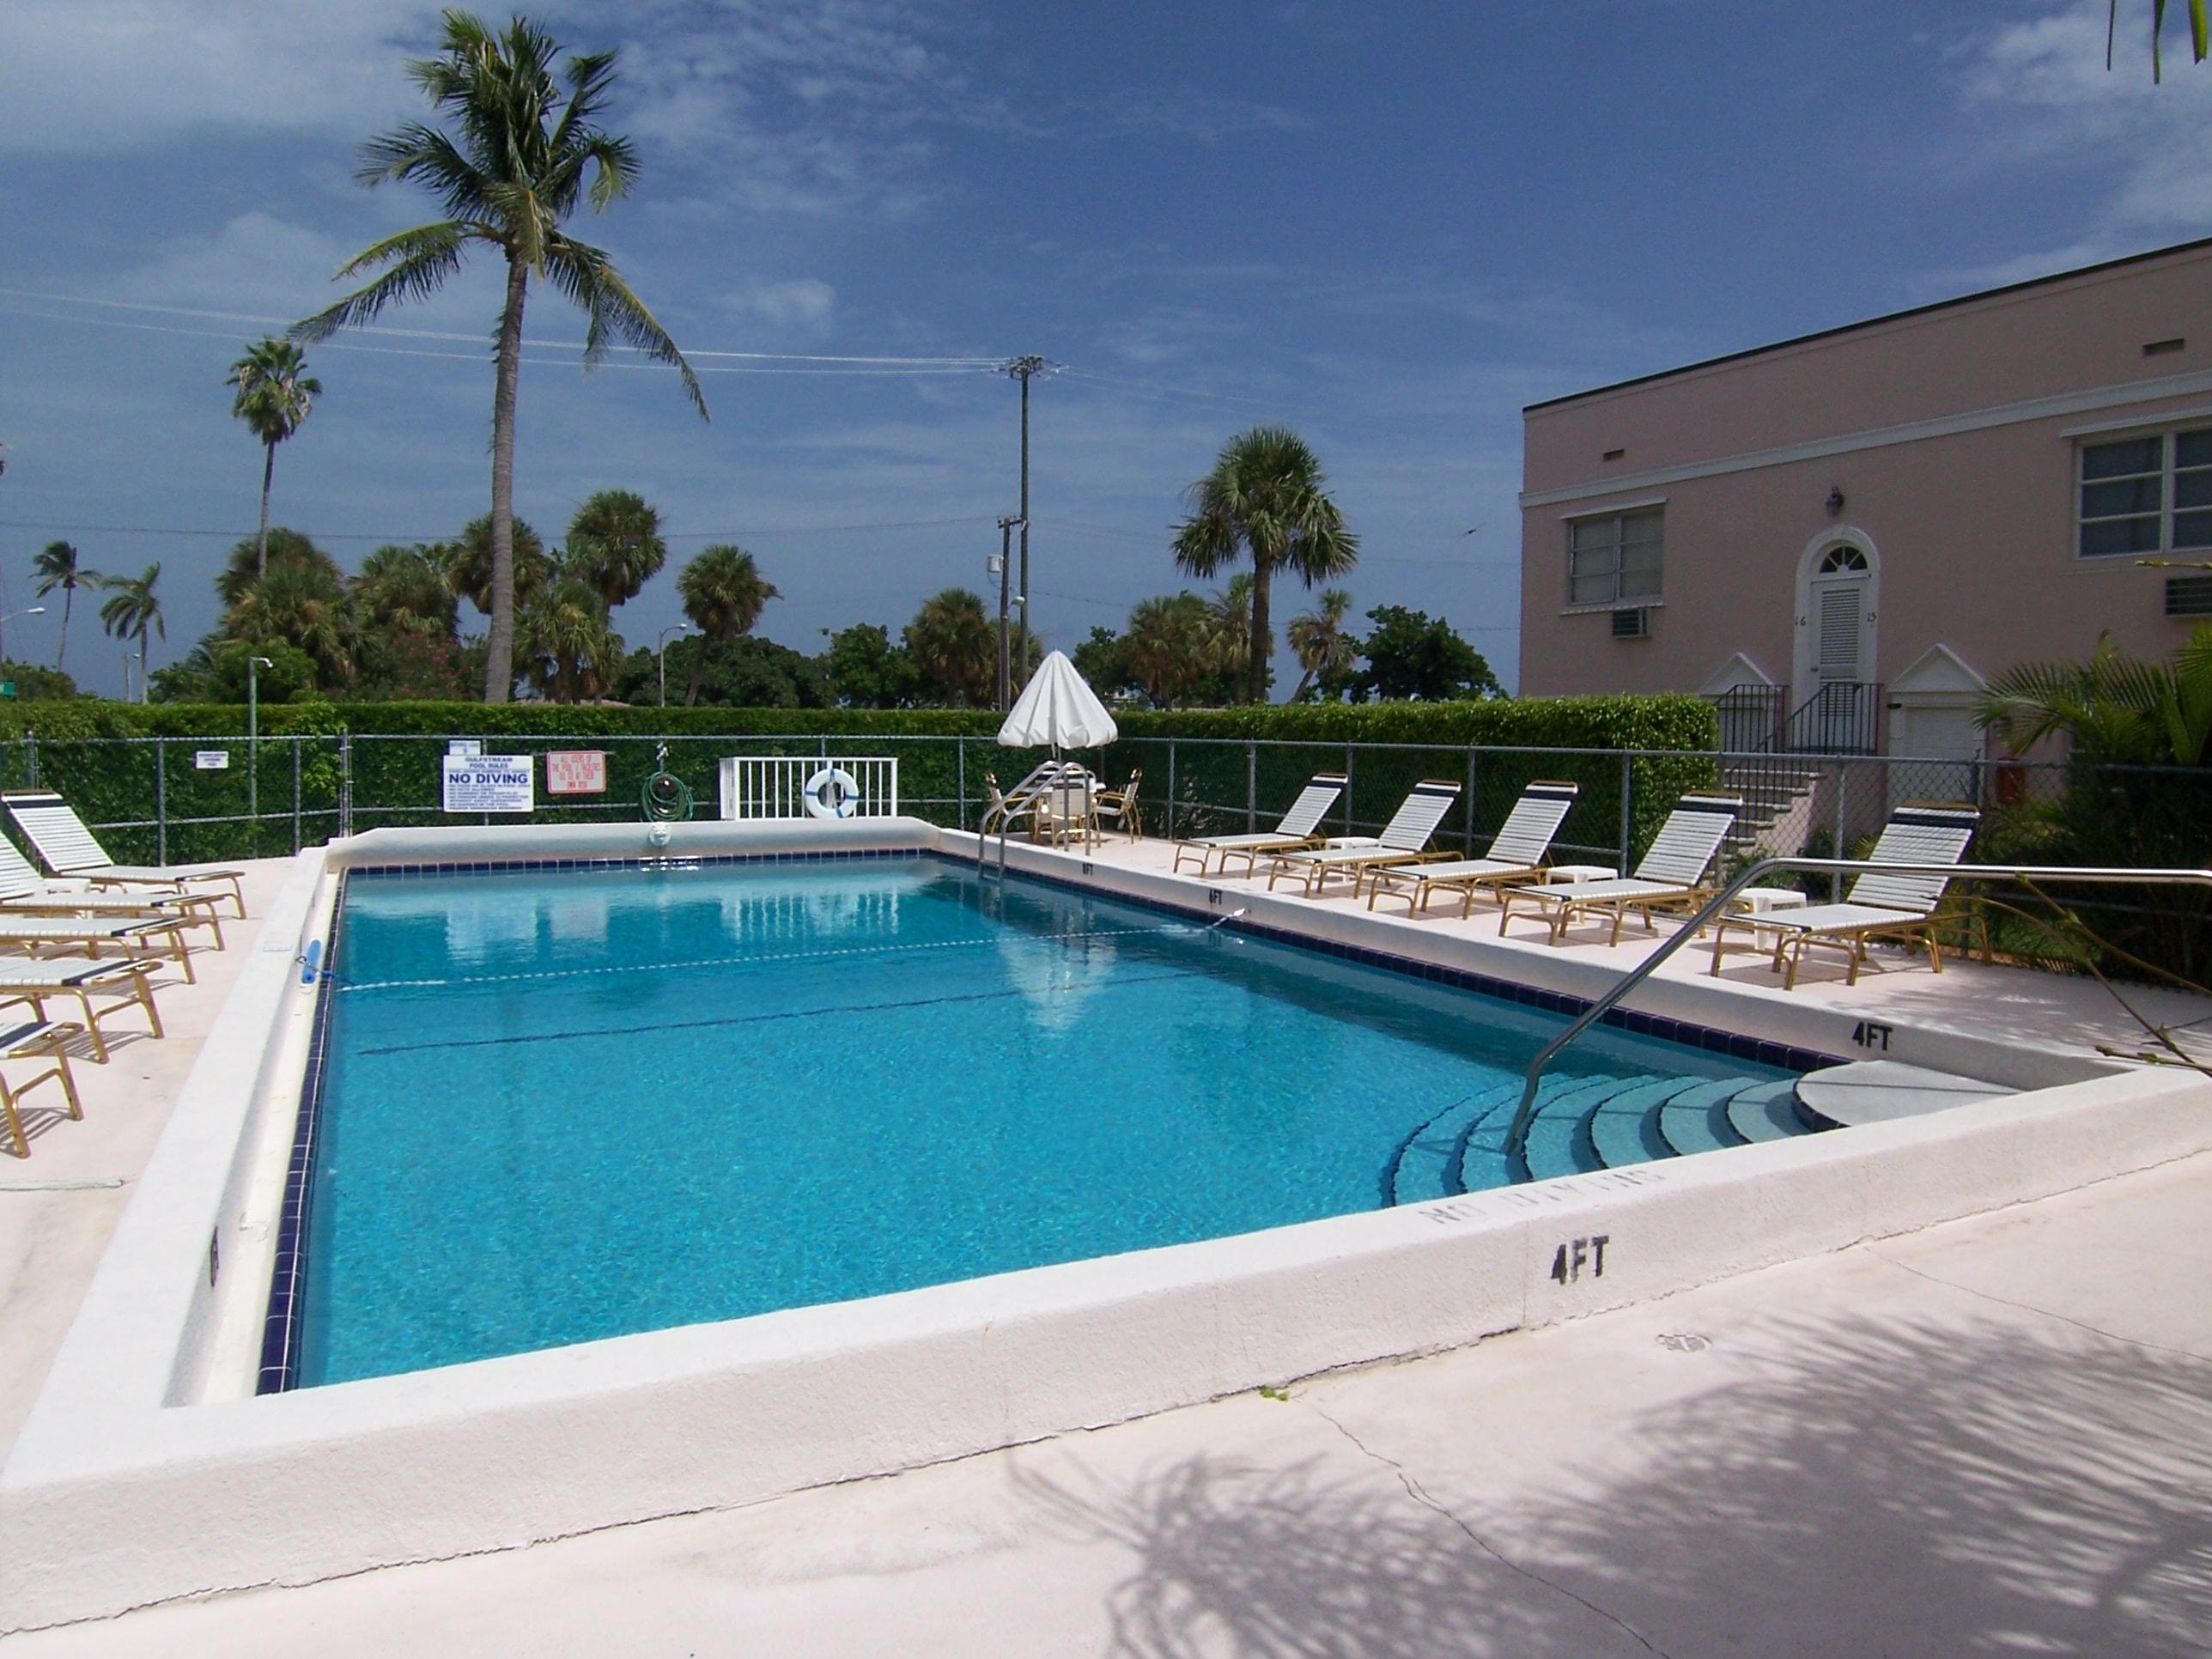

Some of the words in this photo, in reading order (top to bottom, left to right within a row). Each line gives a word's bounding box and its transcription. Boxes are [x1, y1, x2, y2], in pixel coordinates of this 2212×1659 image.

[449, 774, 471, 783] NO
[476, 774, 528, 783] DIVING
[1852, 1022, 1893, 1051] 4FT
[1551, 1235, 1610, 1285] 4FT
